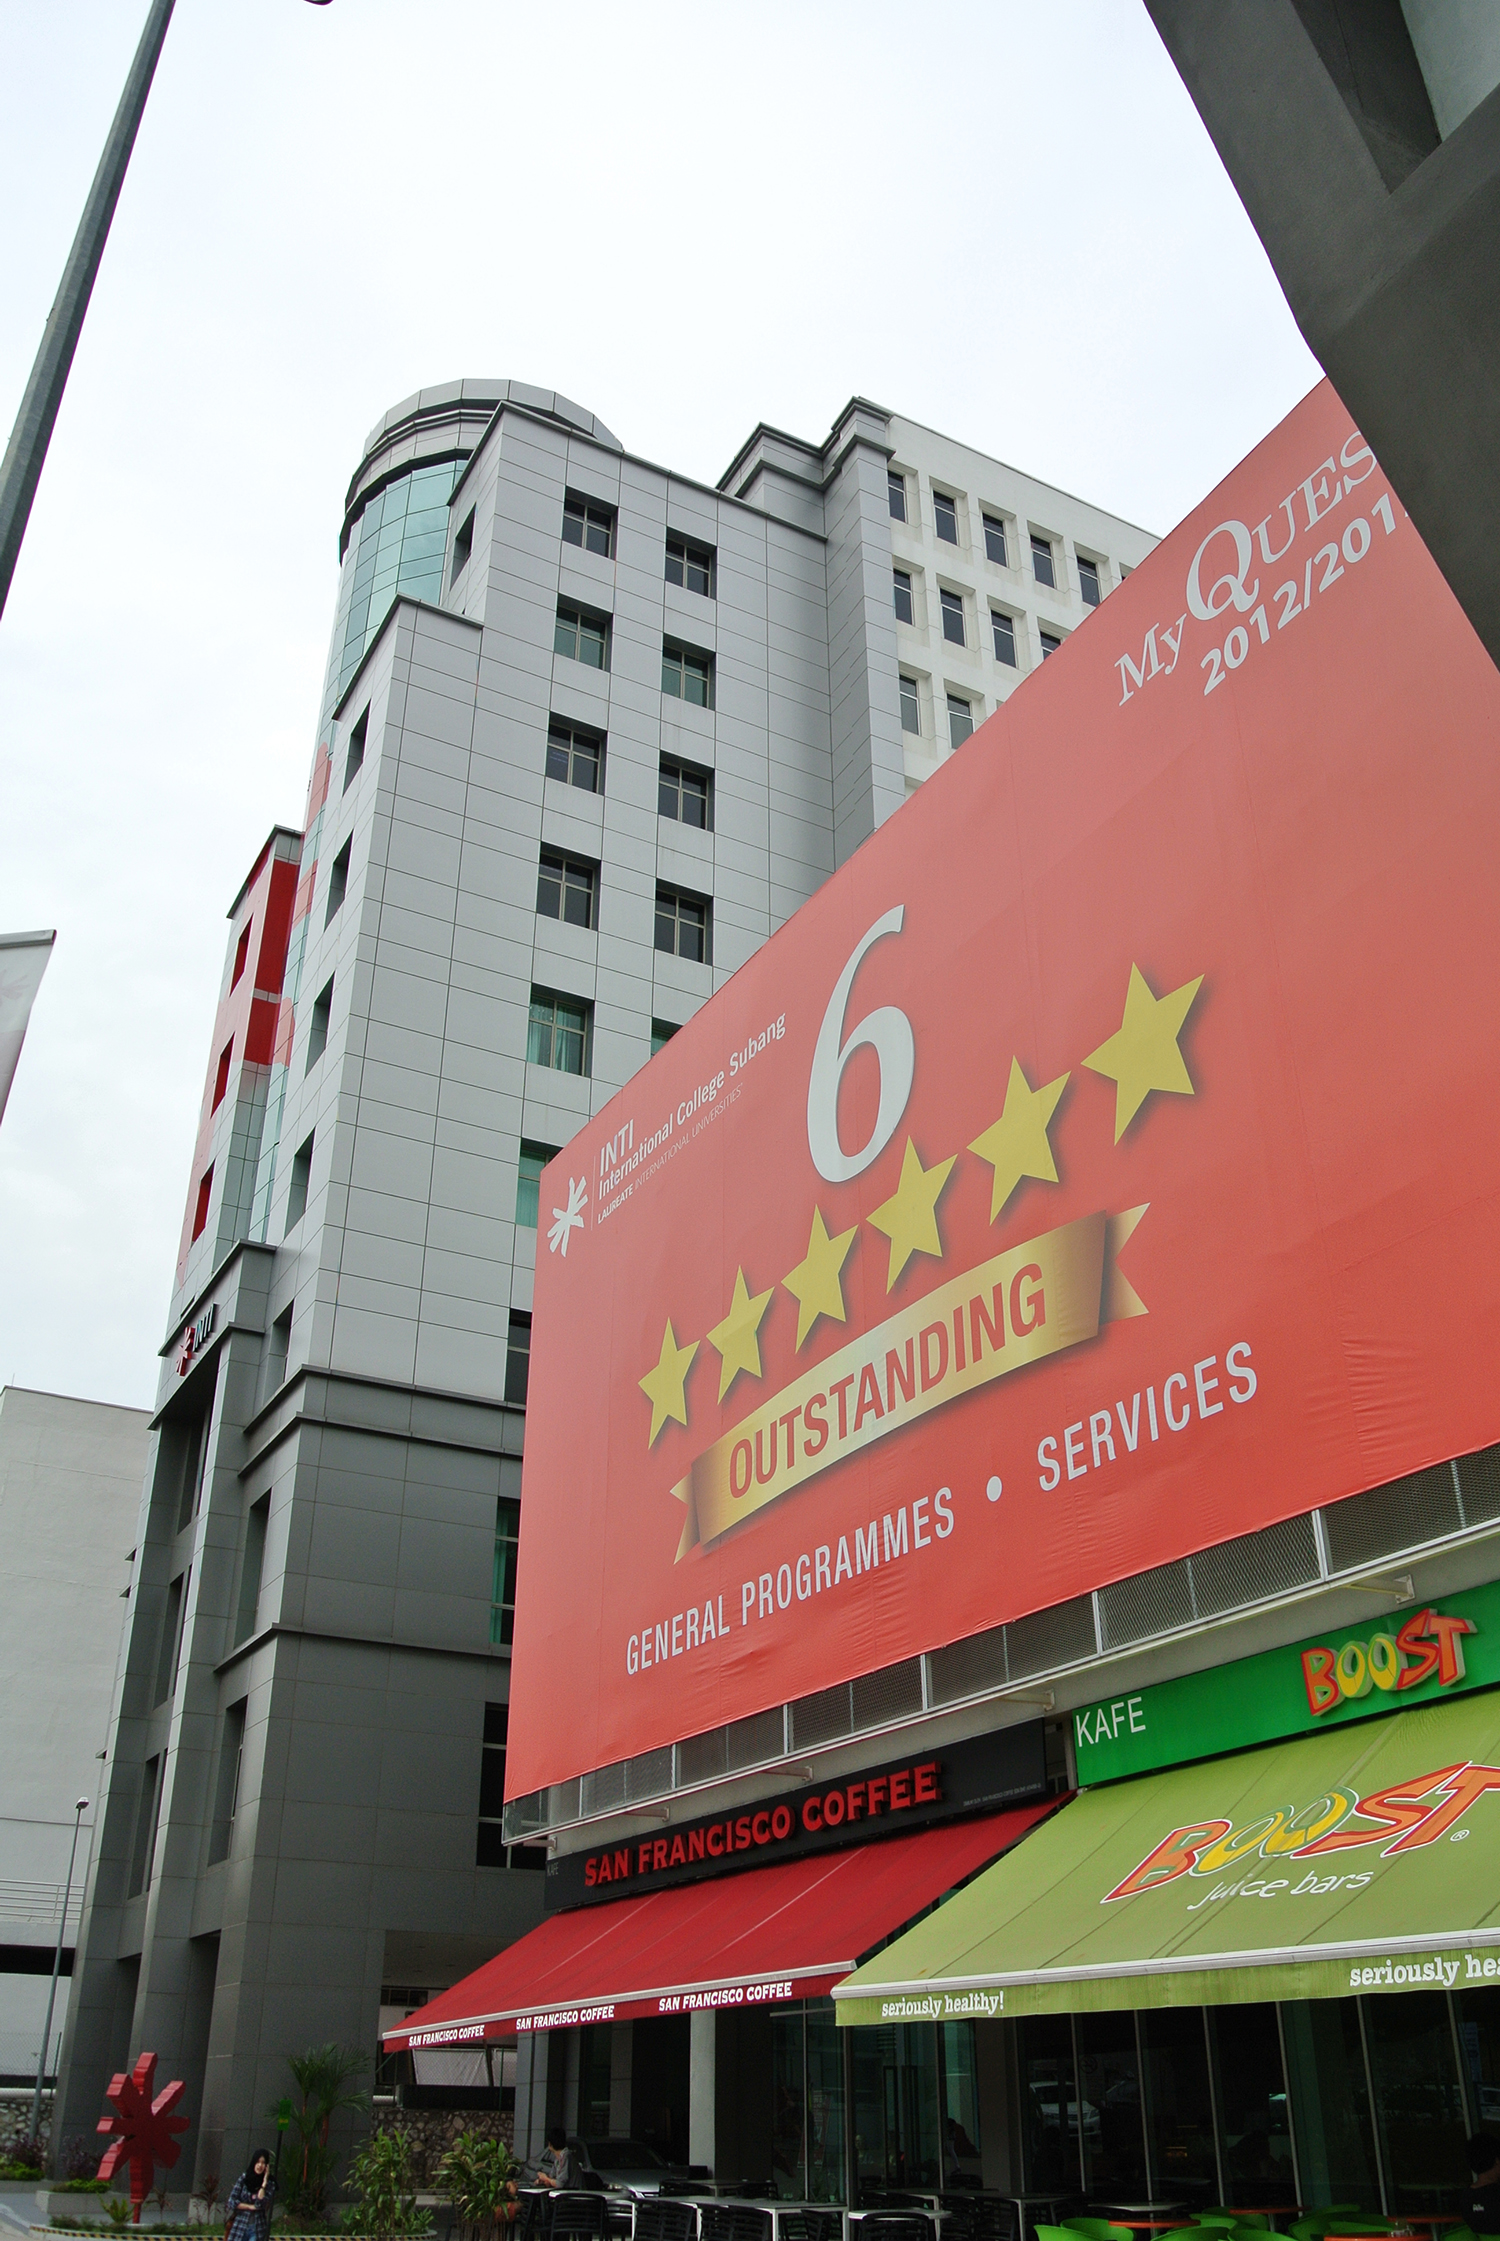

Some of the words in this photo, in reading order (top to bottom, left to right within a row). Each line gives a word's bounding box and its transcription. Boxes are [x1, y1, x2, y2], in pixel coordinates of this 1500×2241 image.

[1200, 492, 1408, 696] 2012/201
[807, 904, 915, 1183] 6
[597, 1183, 634, 1225] LAUREATE
[635, 1133, 691, 1190] INTERNATIONAL
[691, 1084, 743, 1138] UNIVERSITIES
[598, 1113, 674, 1201] International
[677, 1070, 725, 1126] College
[728, 1013, 786, 1077] Subang
[600, 1118, 634, 1178] INTI
[728, 1262, 1047, 1499] OUTSTANDING
[625, 1593, 731, 1675] GENERAL
[741, 1486, 955, 1626] PROGRAMMES
[1036, 1341, 1258, 1492] SERVICES
[1301, 1607, 1478, 1717] BOOST
[1075, 1696, 1146, 1748] KAFE
[584, 1847, 632, 1887] SAN
[637, 1804, 796, 1874] FRANCISCO
[802, 1760, 943, 1832] COFFEE
[1100, 1761, 1500, 1904] BOOST
[1187, 1872, 1290, 1911] juice
[1290, 1870, 1375, 1896] bars
[516, 2017, 532, 2031] SAN
[533, 2009, 579, 2029] FRANCISCO
[580, 2005, 615, 2023] COFFEE
[659, 1997, 681, 2012] SAN
[683, 1988, 744, 2008] FRANCISCO
[746, 1981, 793, 2002] COFFEE
[881, 1996, 942, 2019] seriously
[944, 1990, 1004, 2015] healthy!
[1350, 1956, 1460, 1987] seriously
[1464, 1954, 1500, 1979] he
[408, 2034, 422, 2047] SAN
[422, 2028, 458, 2046] FRANCISCO
[458, 2024, 485, 2041] COFFEE
